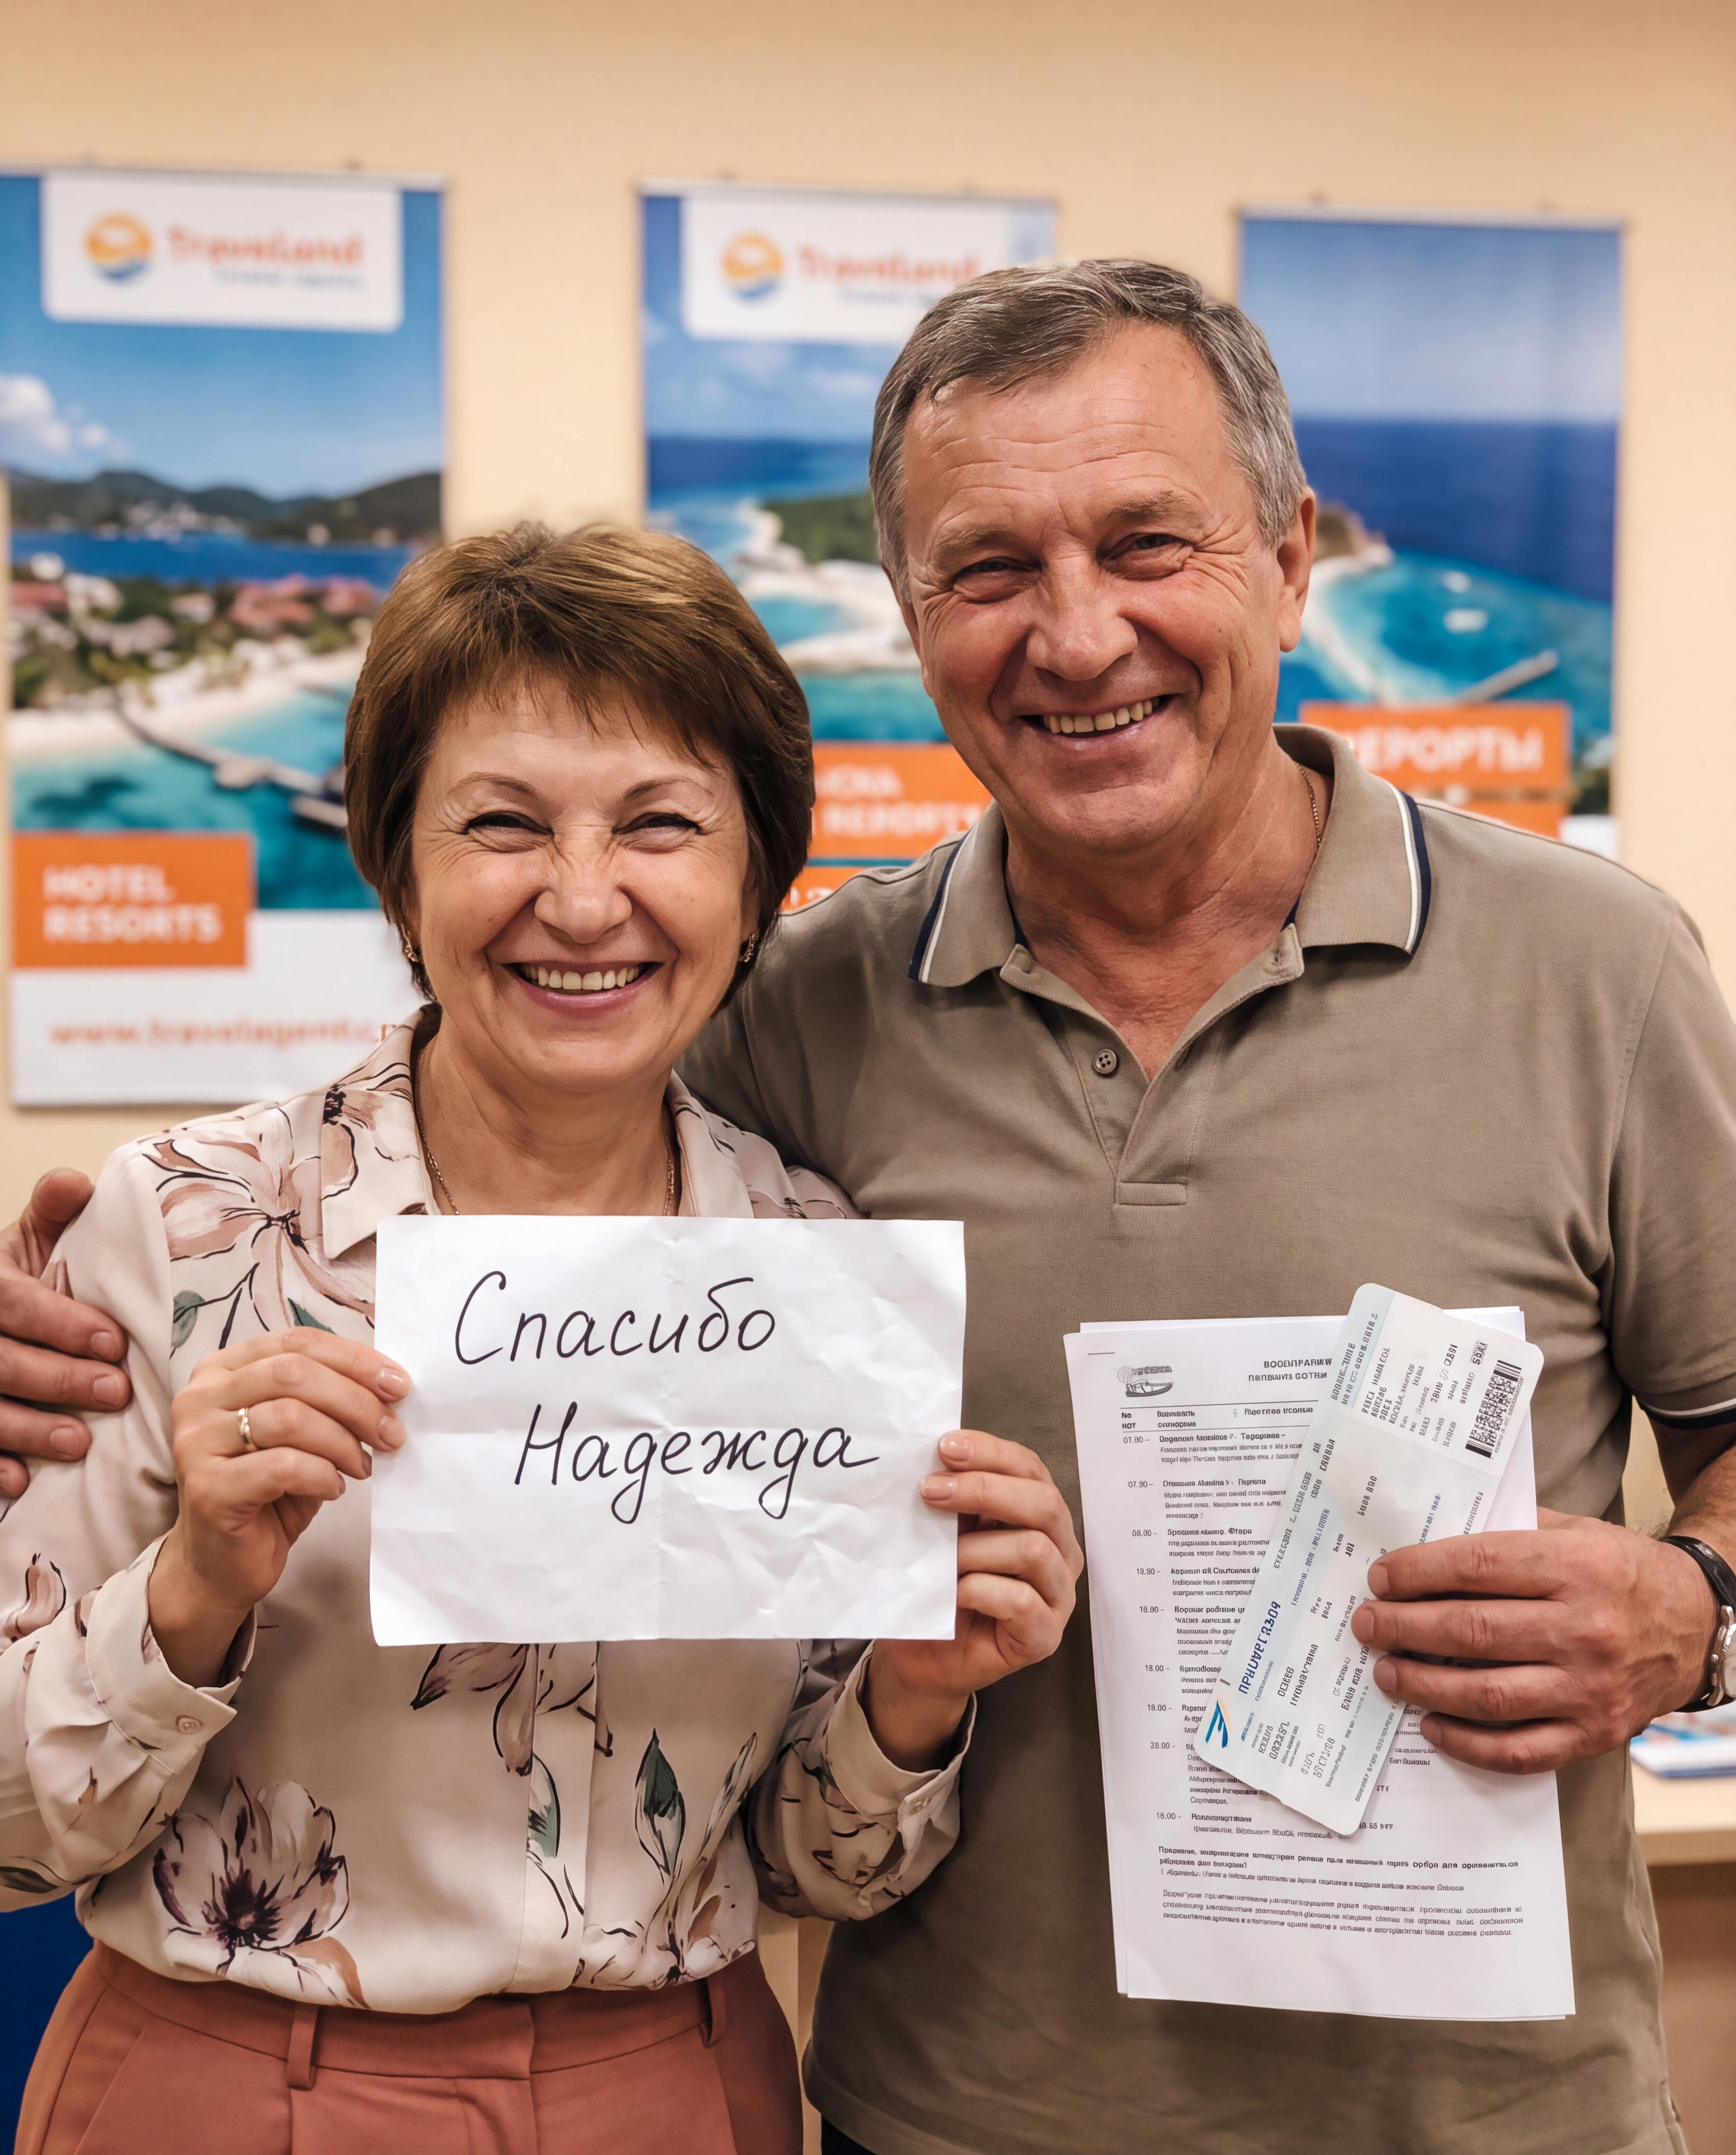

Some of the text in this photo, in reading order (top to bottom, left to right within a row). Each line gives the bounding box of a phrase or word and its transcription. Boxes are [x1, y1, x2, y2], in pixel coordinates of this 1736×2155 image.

[43, 903, 224, 943] RESORTS
[456, 1271, 775, 1365] Спасибо
[514, 1402, 880, 1525] Надежда
